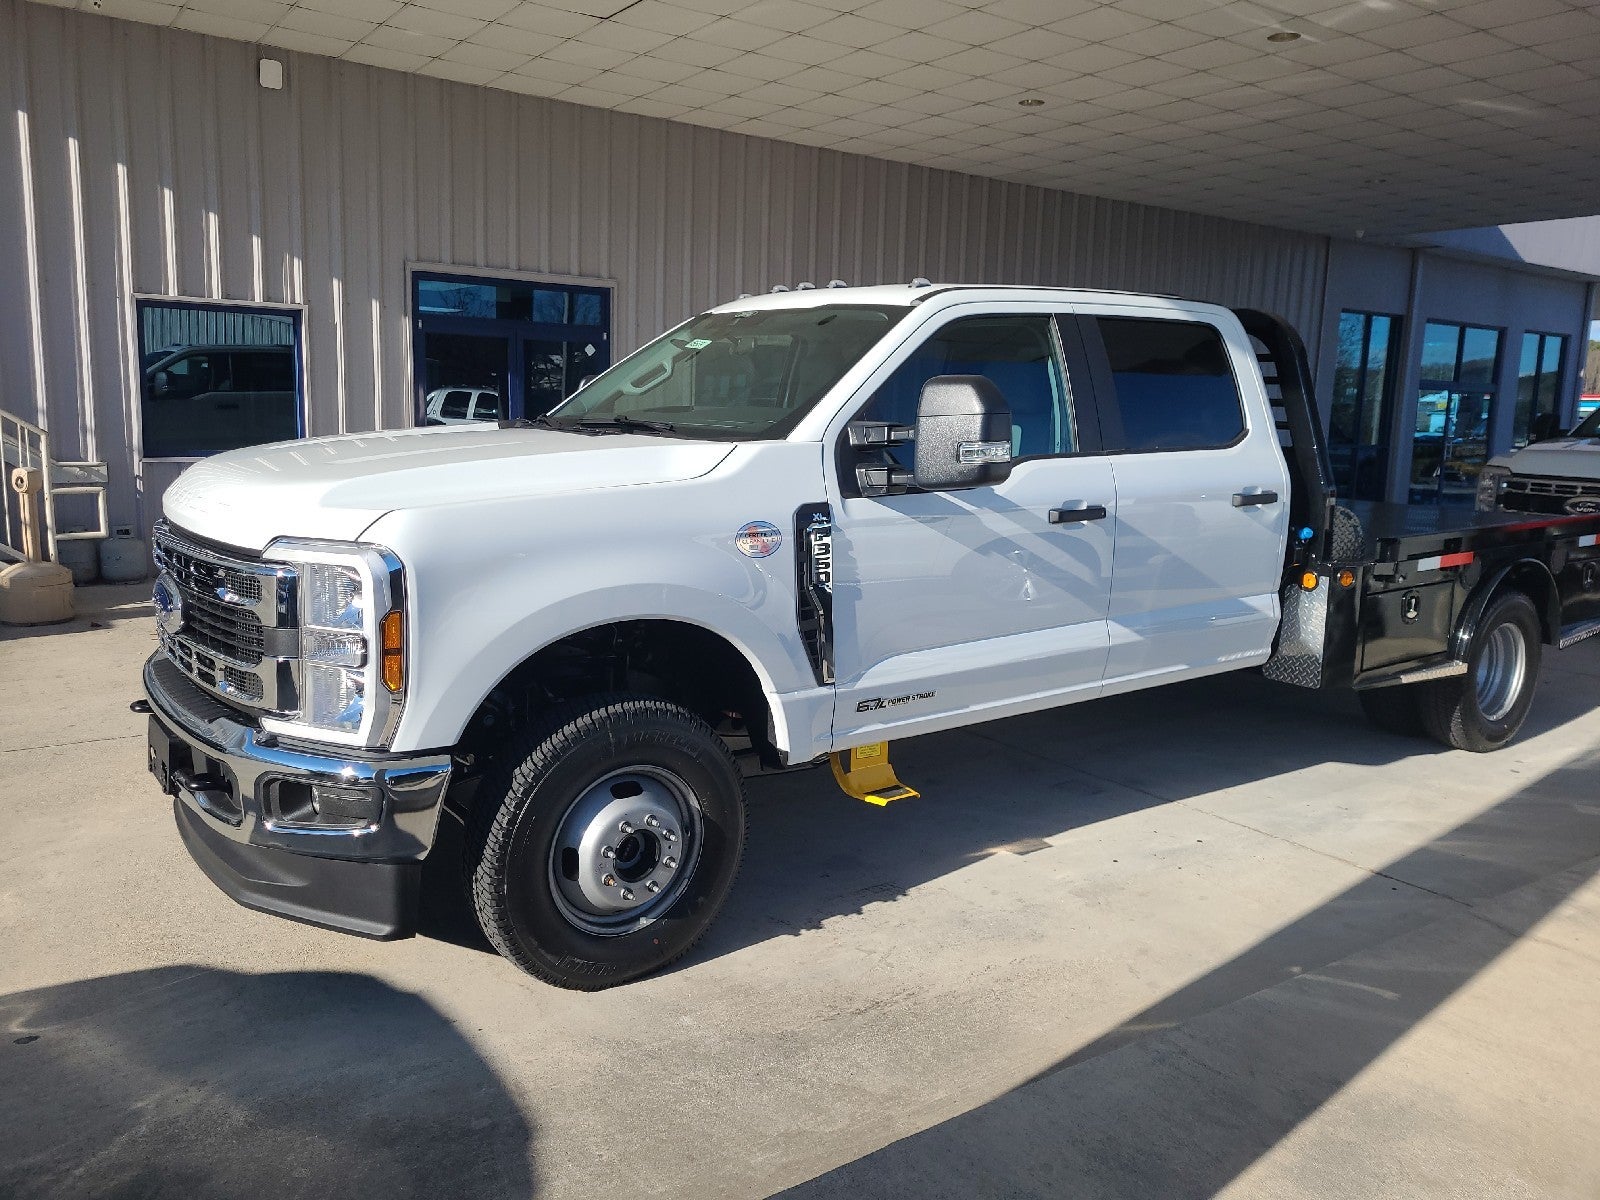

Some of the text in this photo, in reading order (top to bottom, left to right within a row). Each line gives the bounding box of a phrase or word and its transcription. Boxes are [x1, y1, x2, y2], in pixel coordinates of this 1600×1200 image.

[856, 698, 887, 712] 6.7L
[888, 696, 911, 705] POWER
[911, 691, 936, 700] STROKE
